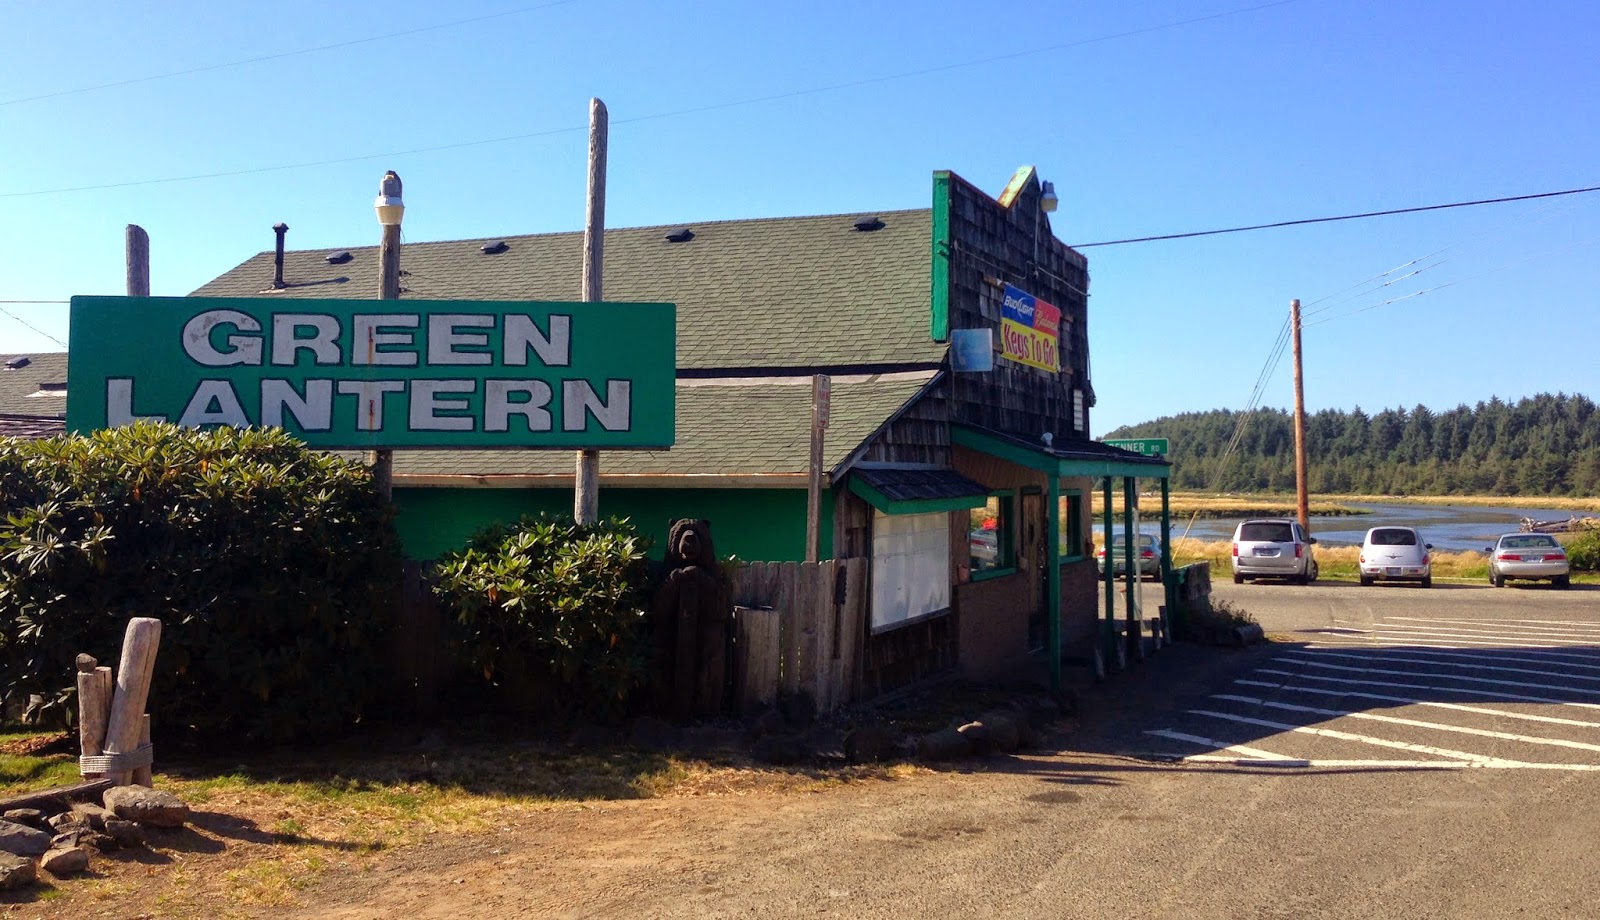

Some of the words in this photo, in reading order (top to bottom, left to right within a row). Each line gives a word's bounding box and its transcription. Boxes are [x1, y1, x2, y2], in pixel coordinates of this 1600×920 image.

[182, 309, 572, 367] GREEN
[1004, 323, 1029, 360] Keys
[1030, 333, 1042, 363] To
[1043, 338, 1055, 367] Go
[106, 376, 632, 432] LANTERN
[1109, 442, 1145, 453] NNER
